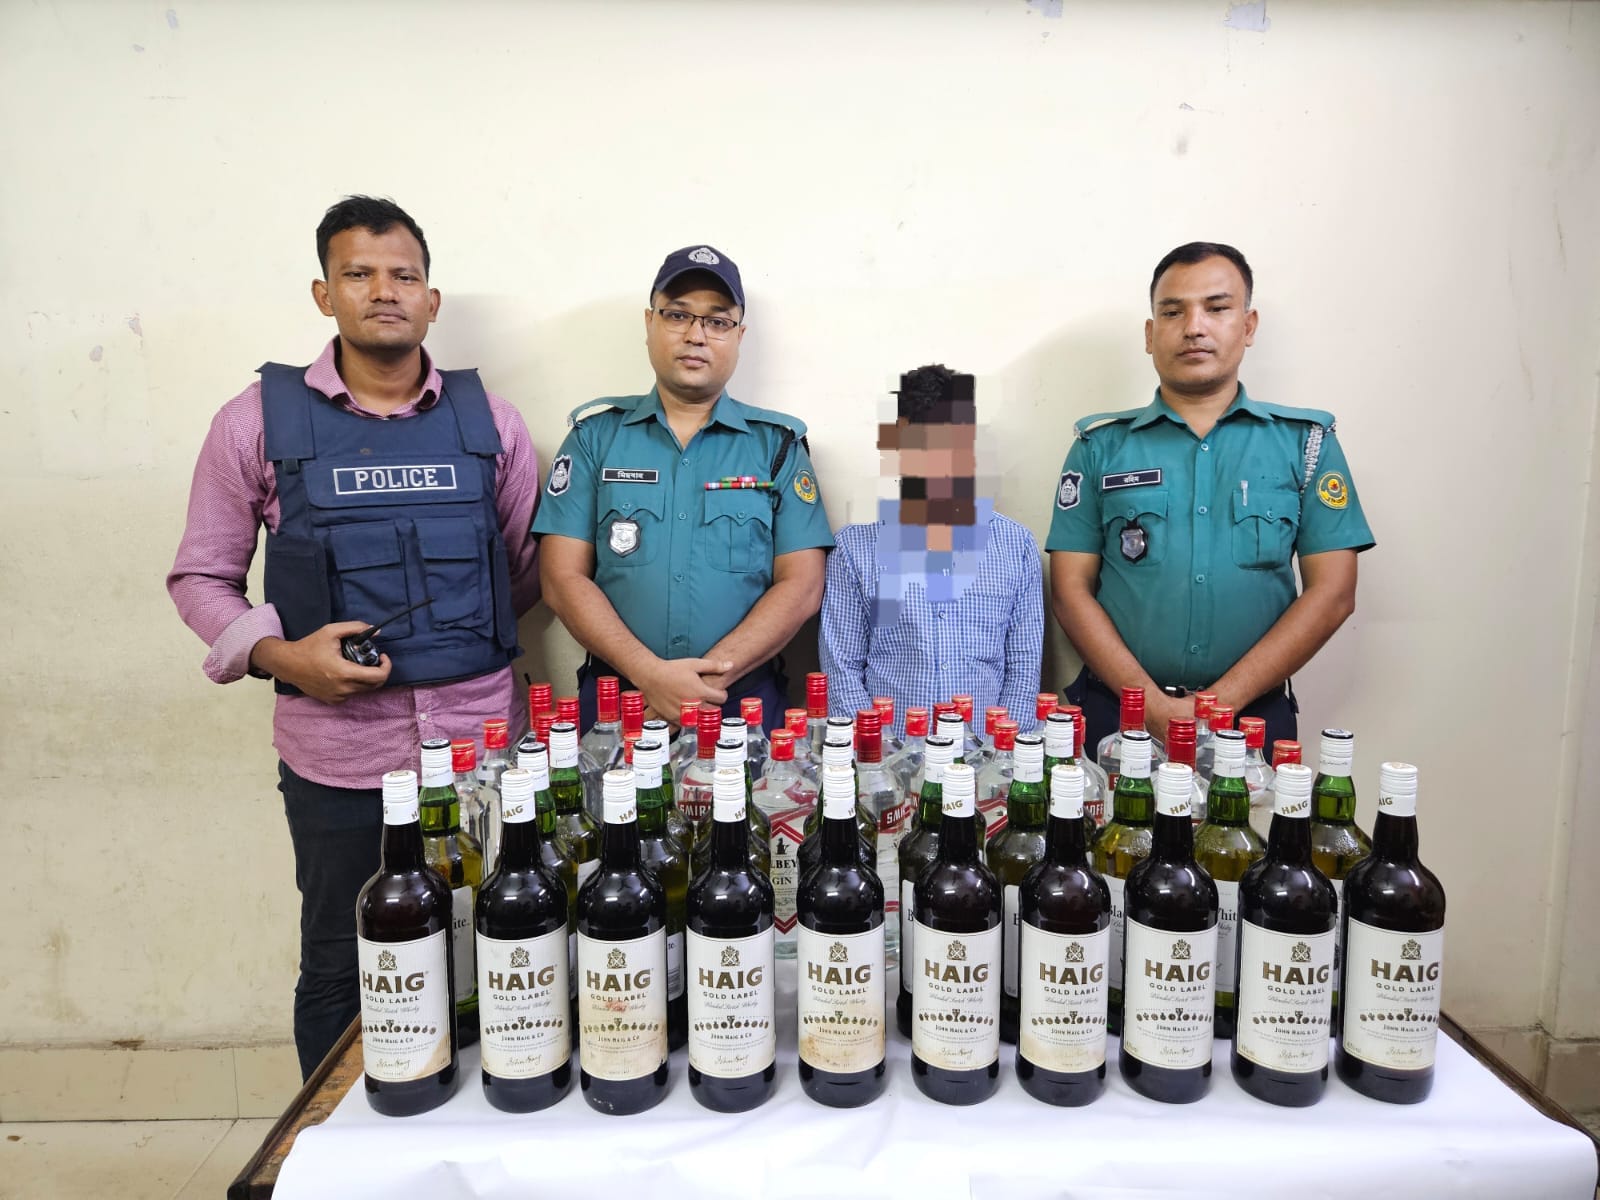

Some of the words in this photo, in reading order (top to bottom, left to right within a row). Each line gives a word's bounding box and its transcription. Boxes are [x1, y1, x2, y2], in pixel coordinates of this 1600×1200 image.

[355, 468, 439, 489] POLICE
[1281, 800, 1308, 814] HAIG
[772, 876, 792, 885] GIN
[807, 961, 872, 985] HAIG
[924, 958, 989, 984] HAIG
[1039, 962, 1103, 985] HAIG
[1145, 958, 1210, 982] HAIG
[1262, 961, 1330, 985] HAIG
[1371, 958, 1440, 983] HAIG
[362, 971, 425, 994] HAIG
[488, 965, 555, 991] HAIG
[586, 968, 651, 992] HAIG
[698, 966, 763, 989] HAIG
[811, 985, 835, 995] GOLD
[839, 987, 866, 995] LABEL
[928, 982, 952, 992] GOLD
[957, 986, 984, 994] LABEL
[1044, 986, 1070, 995] GOLD
[1074, 987, 1099, 995] LABEL
[1149, 982, 1176, 992] GOLD
[1180, 984, 1206, 992] LABEL
[1267, 985, 1295, 995] GOLD
[1300, 987, 1325, 995] LABEL
[1376, 982, 1405, 992] GOLD
[1410, 985, 1435, 993] LABEL
[365, 993, 385, 1004] GOLD
[389, 995, 420, 1004] LABEL
[521, 989, 550, 1001] LABEL
[590, 993, 614, 1002] GOLD
[617, 992, 647, 1002] LABEL
[703, 991, 727, 1000] GOLD
[731, 990, 759, 1000] LABEL
